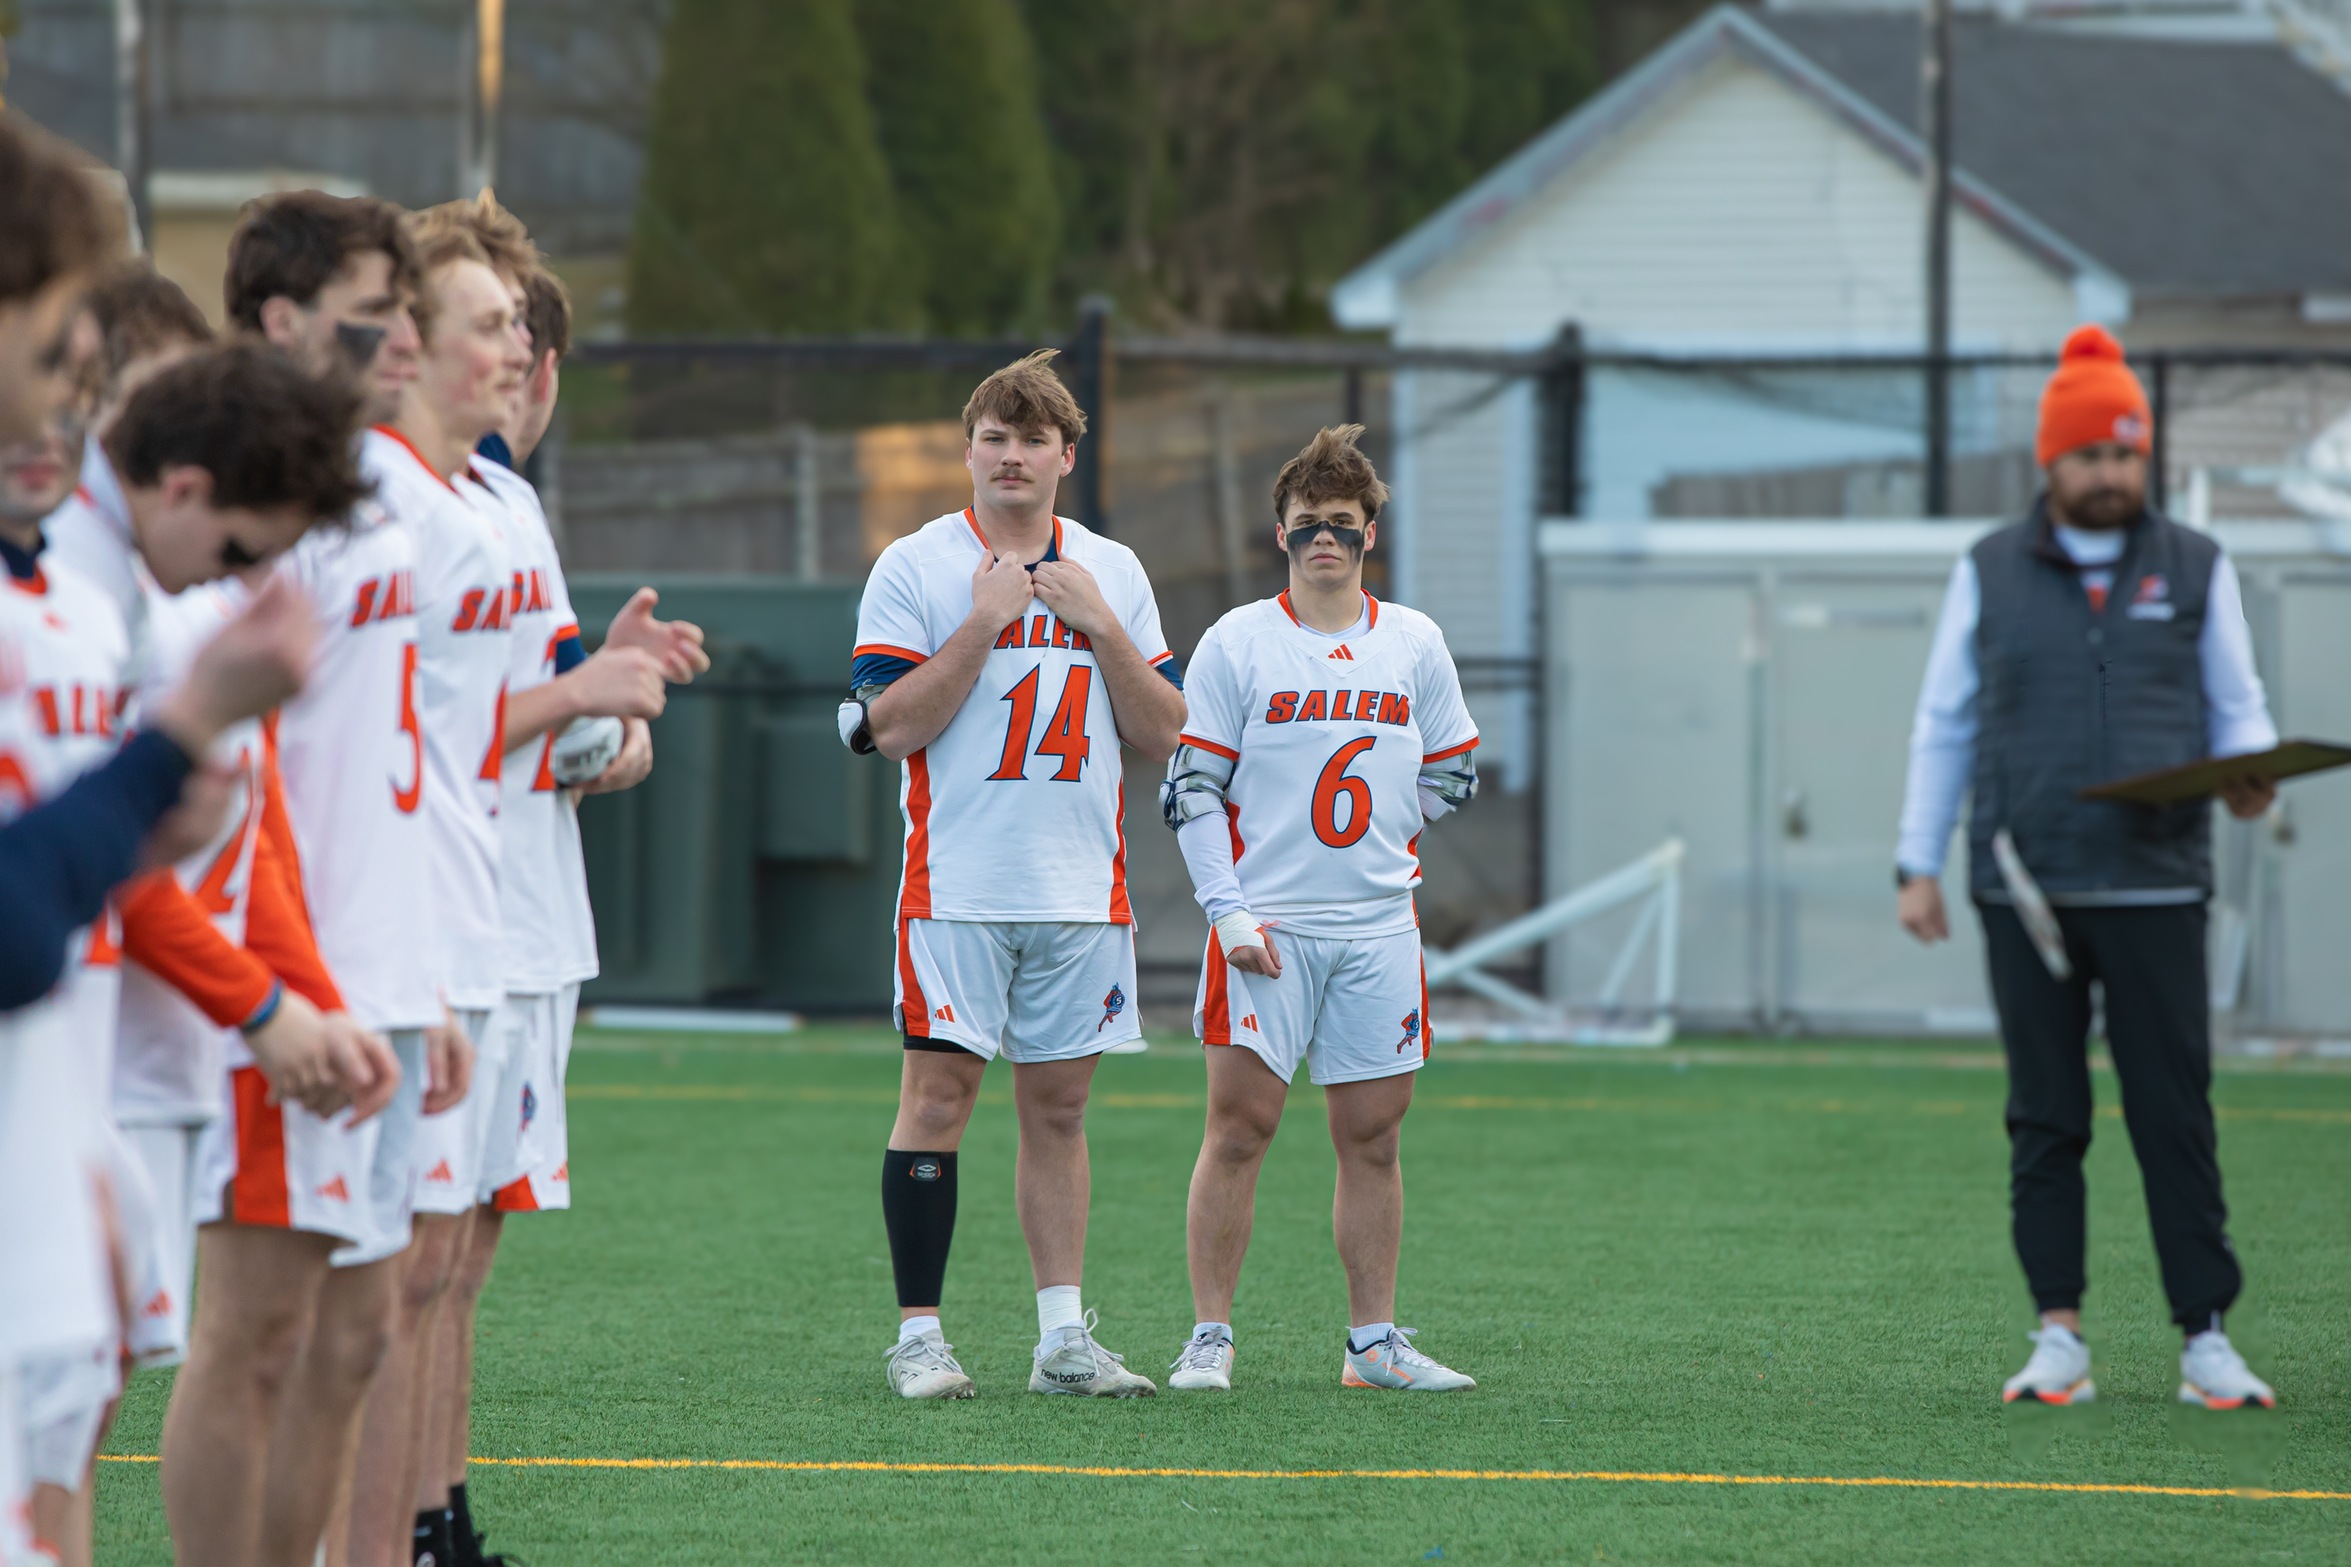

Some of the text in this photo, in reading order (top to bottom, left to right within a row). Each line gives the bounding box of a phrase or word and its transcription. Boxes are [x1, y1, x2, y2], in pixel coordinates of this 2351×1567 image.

[992, 614, 1094, 652] ALE
[985, 662, 1092, 783] 14
[1265, 689, 1410, 727] SALEM
[1311, 735, 1378, 849] 6
[1040, 1368, 1096, 1384] new balance
